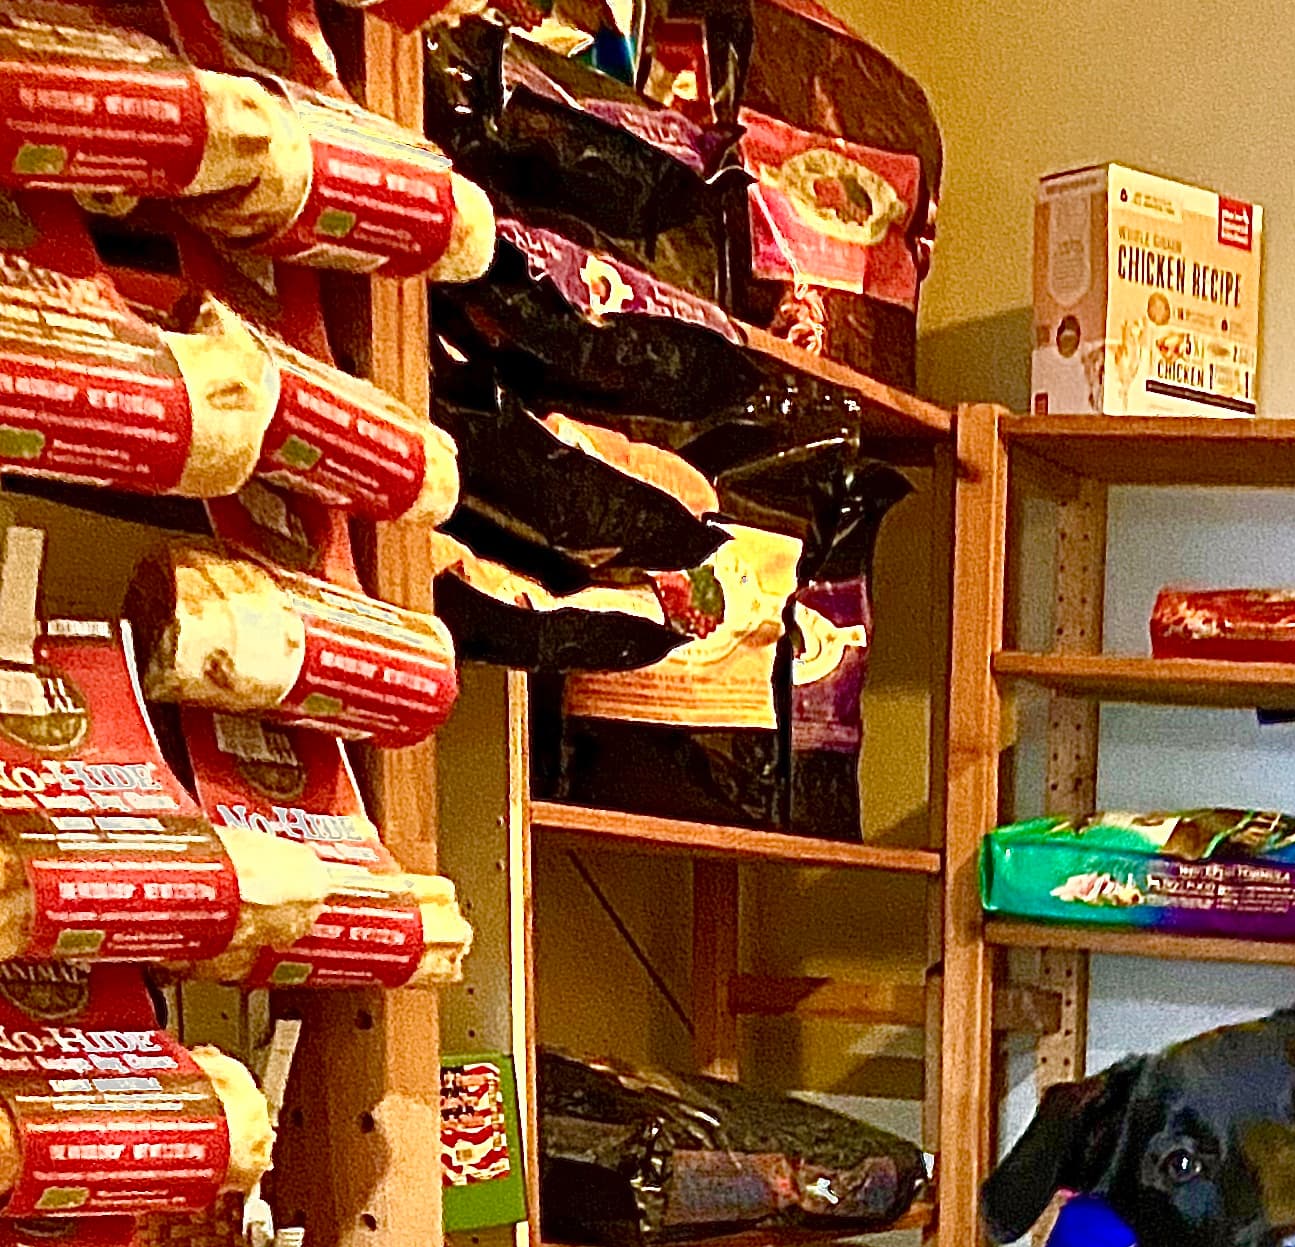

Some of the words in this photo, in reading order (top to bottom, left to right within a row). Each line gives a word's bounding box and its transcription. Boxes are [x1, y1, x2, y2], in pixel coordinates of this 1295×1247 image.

[1117, 243, 1187, 296] CHICKEN
[1191, 261, 1242, 308] RECIPE
[1156, 358, 1205, 388] CHICKEN
